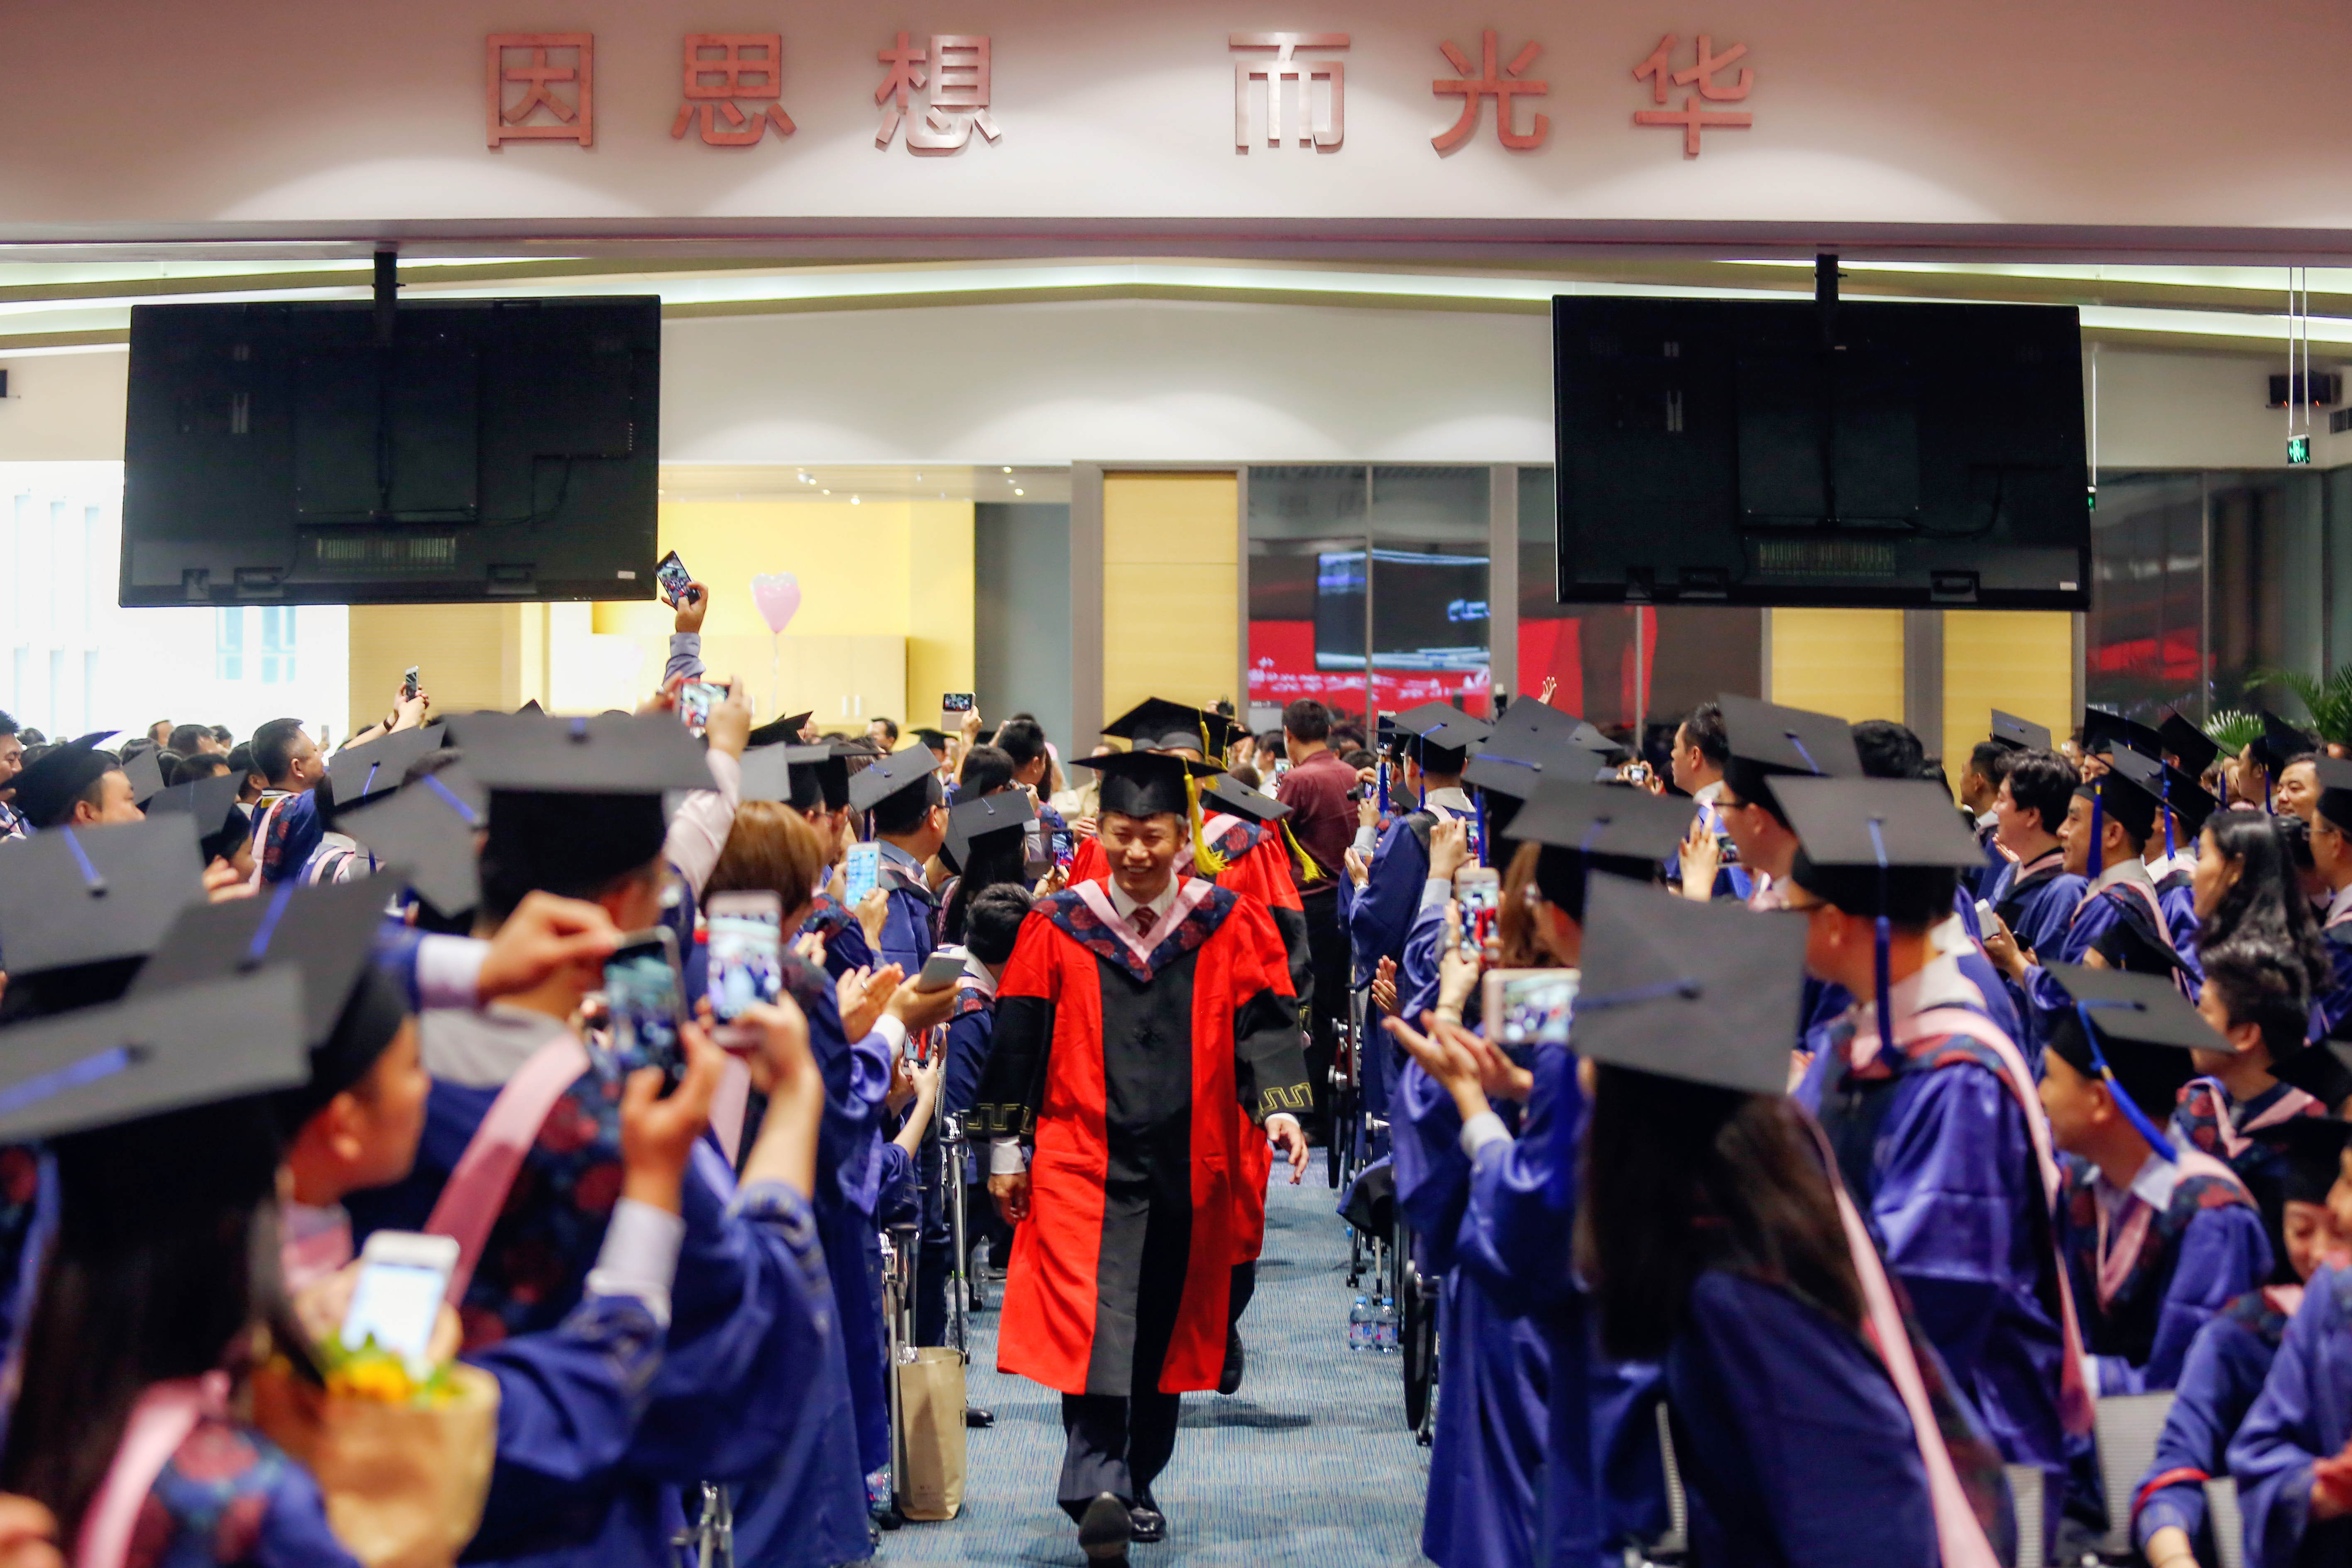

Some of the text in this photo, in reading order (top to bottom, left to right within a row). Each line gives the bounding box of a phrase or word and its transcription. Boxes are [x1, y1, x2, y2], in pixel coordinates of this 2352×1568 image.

[486, 30, 1753, 157] 因思想 而光华
